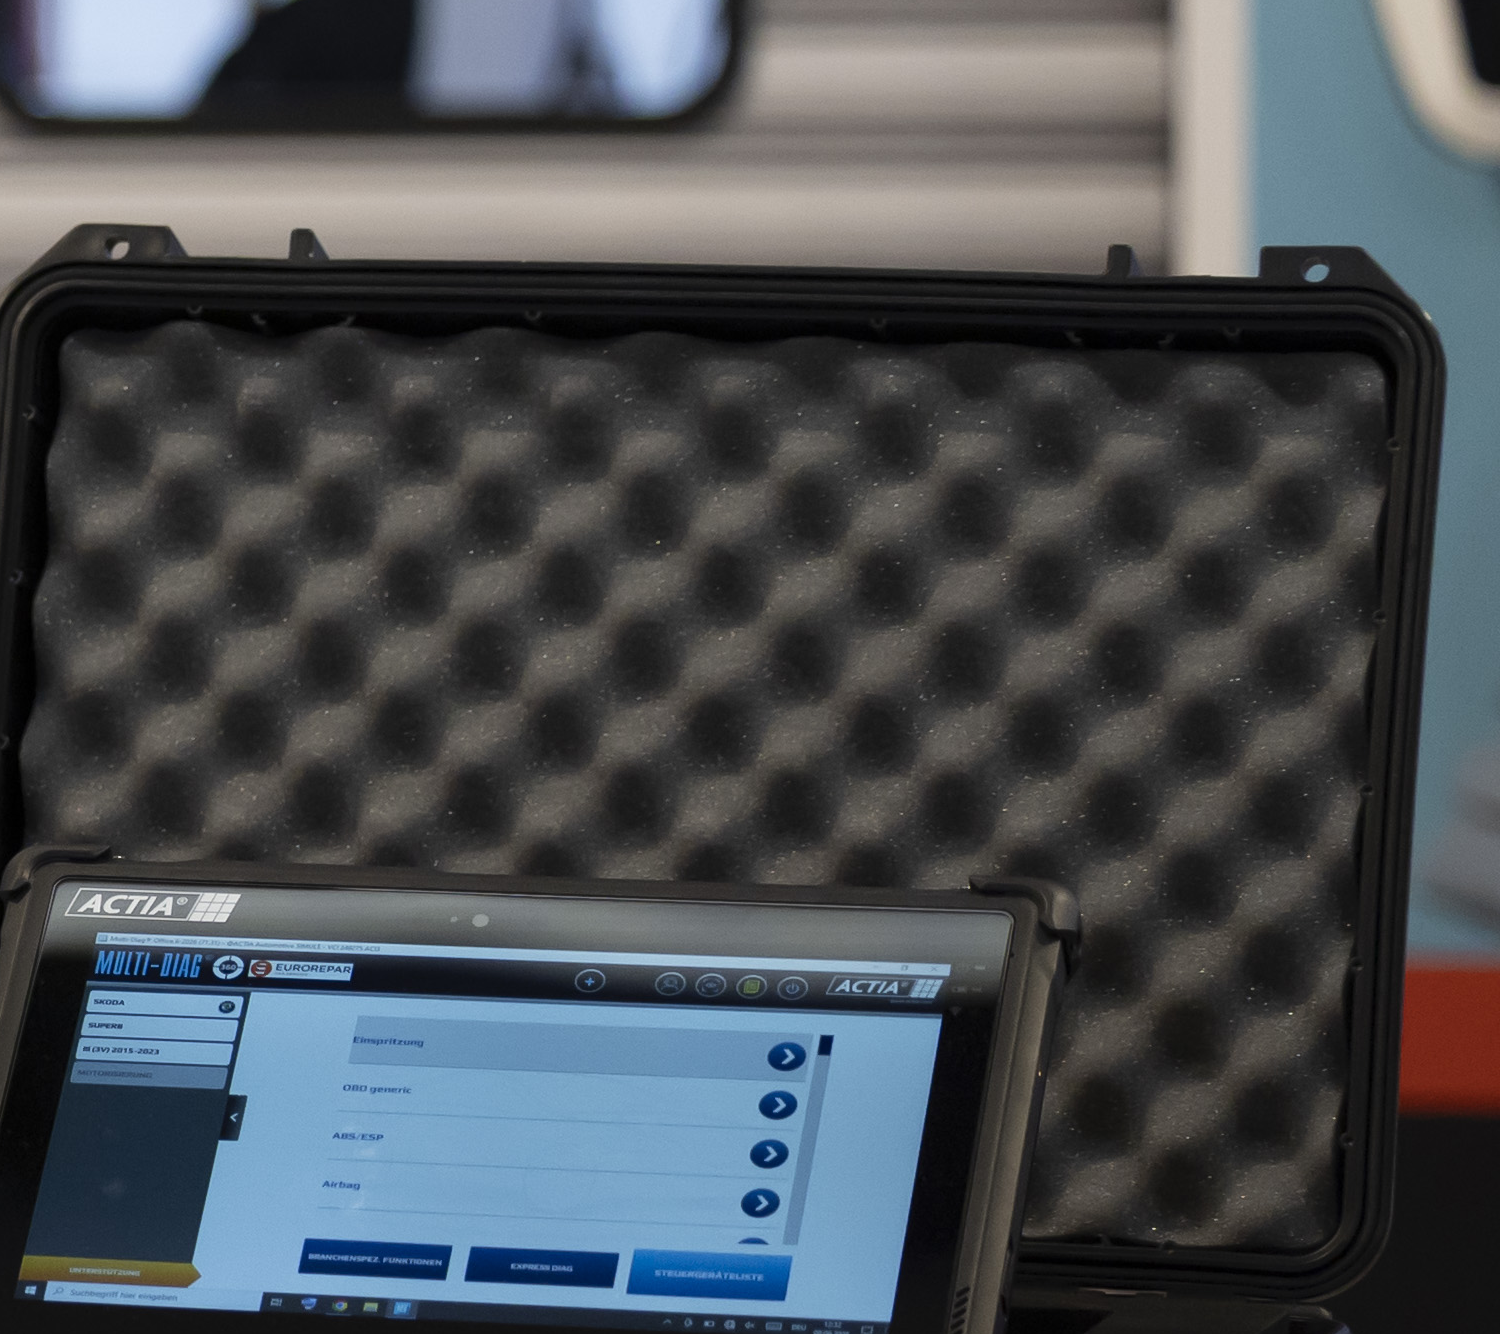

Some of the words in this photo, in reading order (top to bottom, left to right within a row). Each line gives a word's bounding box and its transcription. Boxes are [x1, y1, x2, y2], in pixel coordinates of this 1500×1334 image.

[275, 963, 352, 974] EUROREPAR
[93, 998, 125, 1006] SKODA
[353, 1036, 425, 1048] Einspritzung
[342, 1084, 368, 1093] OBD
[369, 1086, 413, 1095] generic
[332, 1132, 385, 1141] ABS/ESP
[322, 1180, 361, 1191] Airbag
[382, 1256, 443, 1267] FUNKTIONEN
[69, 1288, 119, 1300] Suchbegriff
